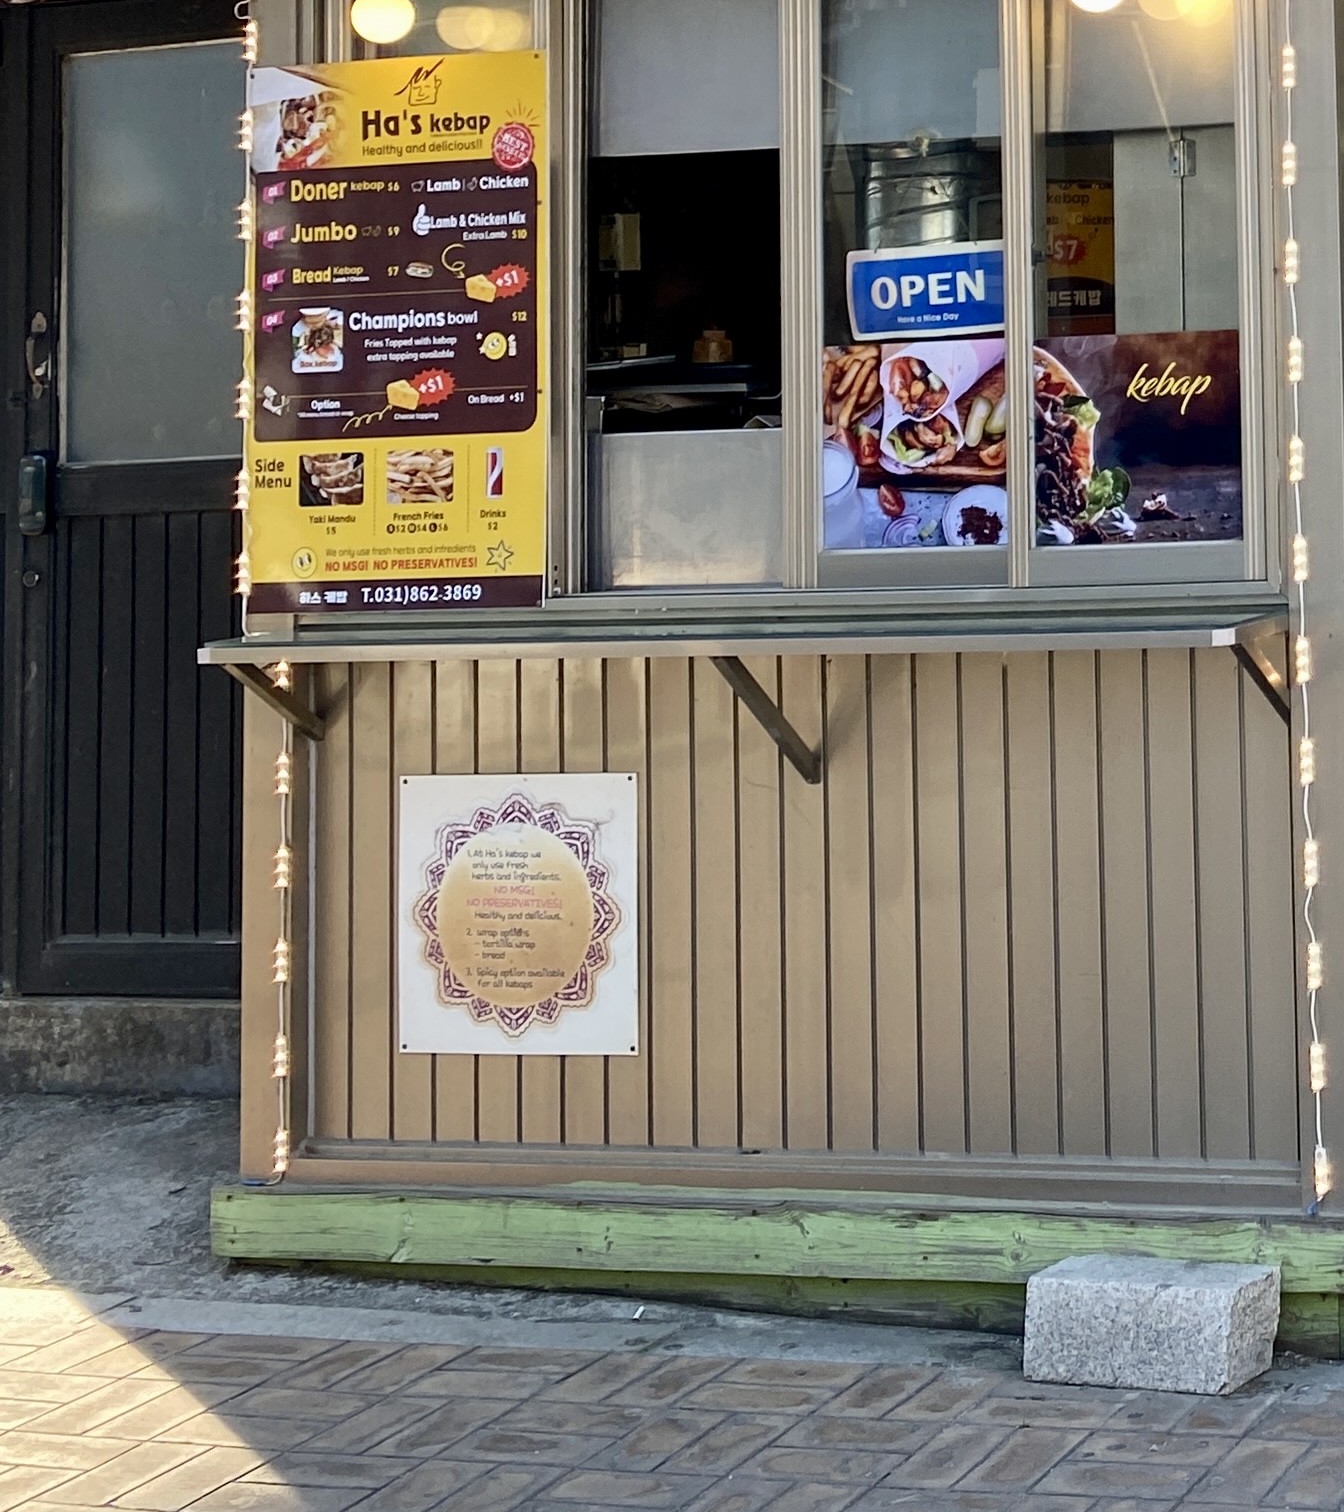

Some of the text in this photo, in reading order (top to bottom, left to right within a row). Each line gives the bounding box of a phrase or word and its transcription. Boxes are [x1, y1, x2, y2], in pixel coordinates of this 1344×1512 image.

[361, 109, 491, 141] Ha's kebap
[362, 143, 426, 157] Healthy and
[290, 179, 384, 202] Doner kebap
[426, 175, 529, 192] Lamb Chicken
[467, 213, 508, 228] Chicken
[290, 221, 358, 243] Jumbo
[292, 266, 331, 284] Bread
[870, 269, 986, 310] OPEN
[349, 309, 478, 332] Champions bowl
[1126, 361, 1212, 416] kebap
[311, 399, 341, 412] Option
[255, 458, 285, 473] Side
[254, 474, 292, 489] Menu
[360, 584, 482, 605] T.031)862-3869
